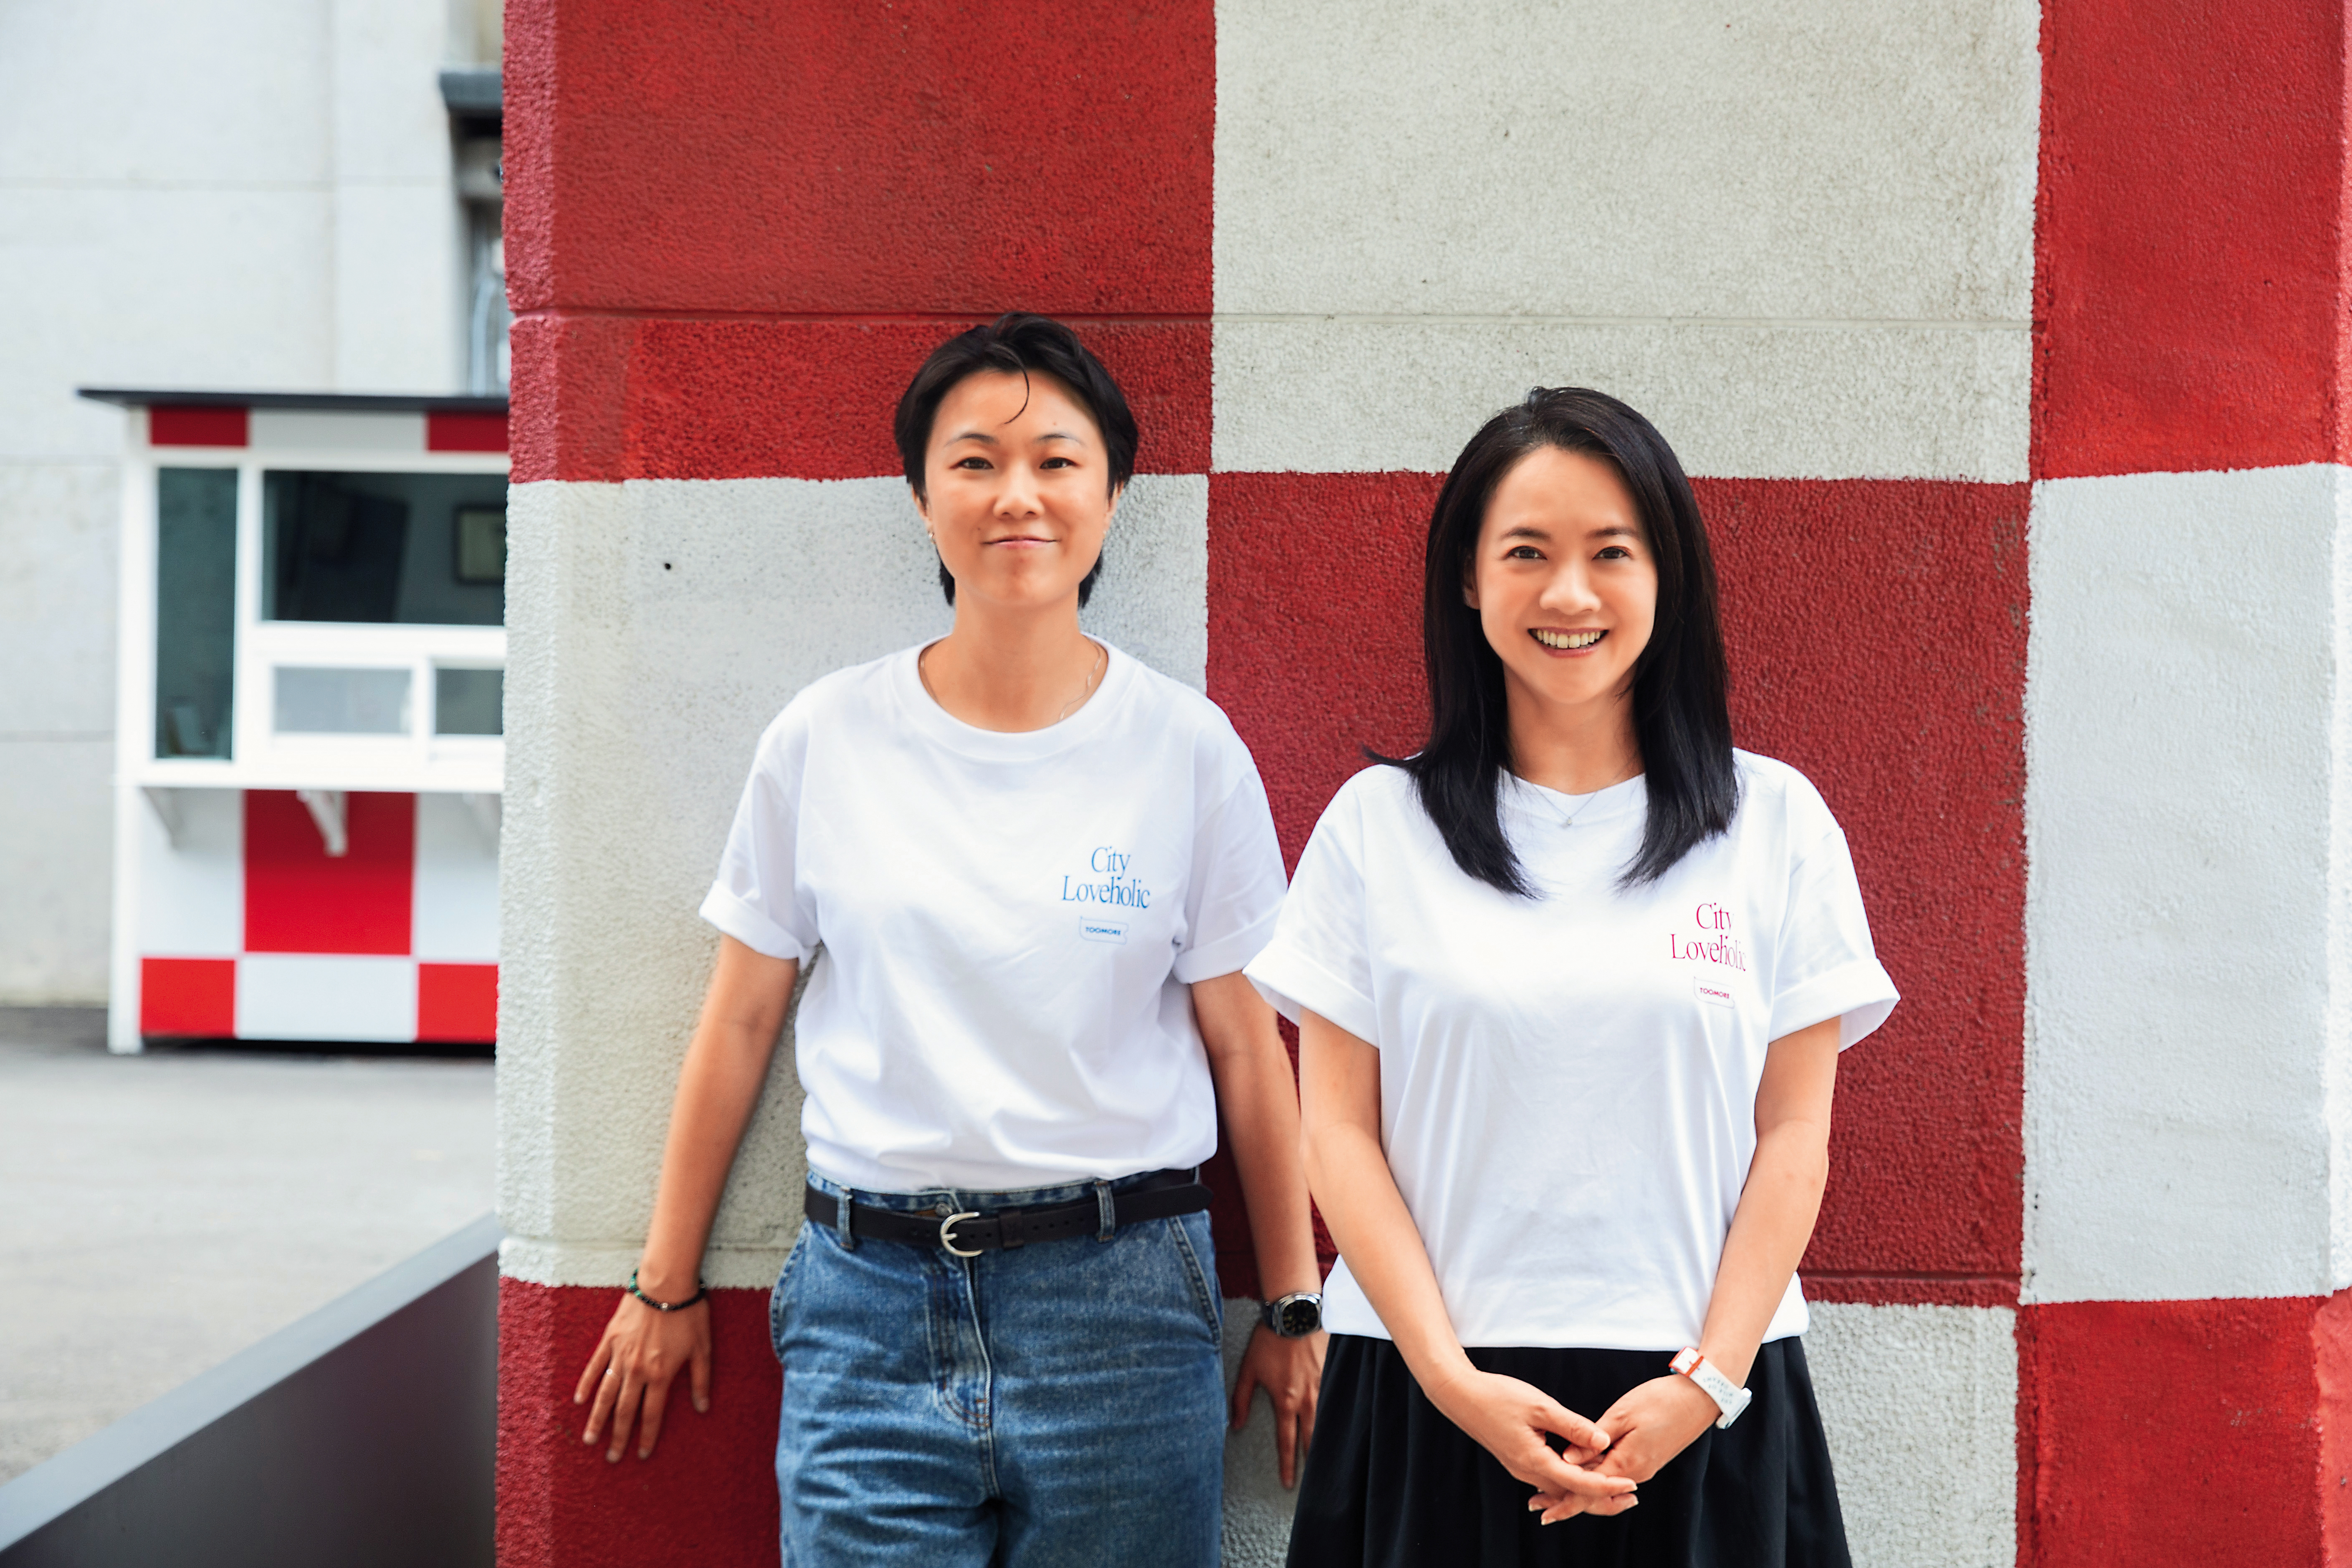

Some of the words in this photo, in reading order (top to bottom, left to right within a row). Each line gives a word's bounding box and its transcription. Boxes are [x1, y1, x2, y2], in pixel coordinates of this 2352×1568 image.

[1091, 846, 1130, 880] City
[1062, 875, 1150, 909] Loveholic
[1696, 902, 1734, 939] City
[1700, 987, 1730, 999] TOOMORE
